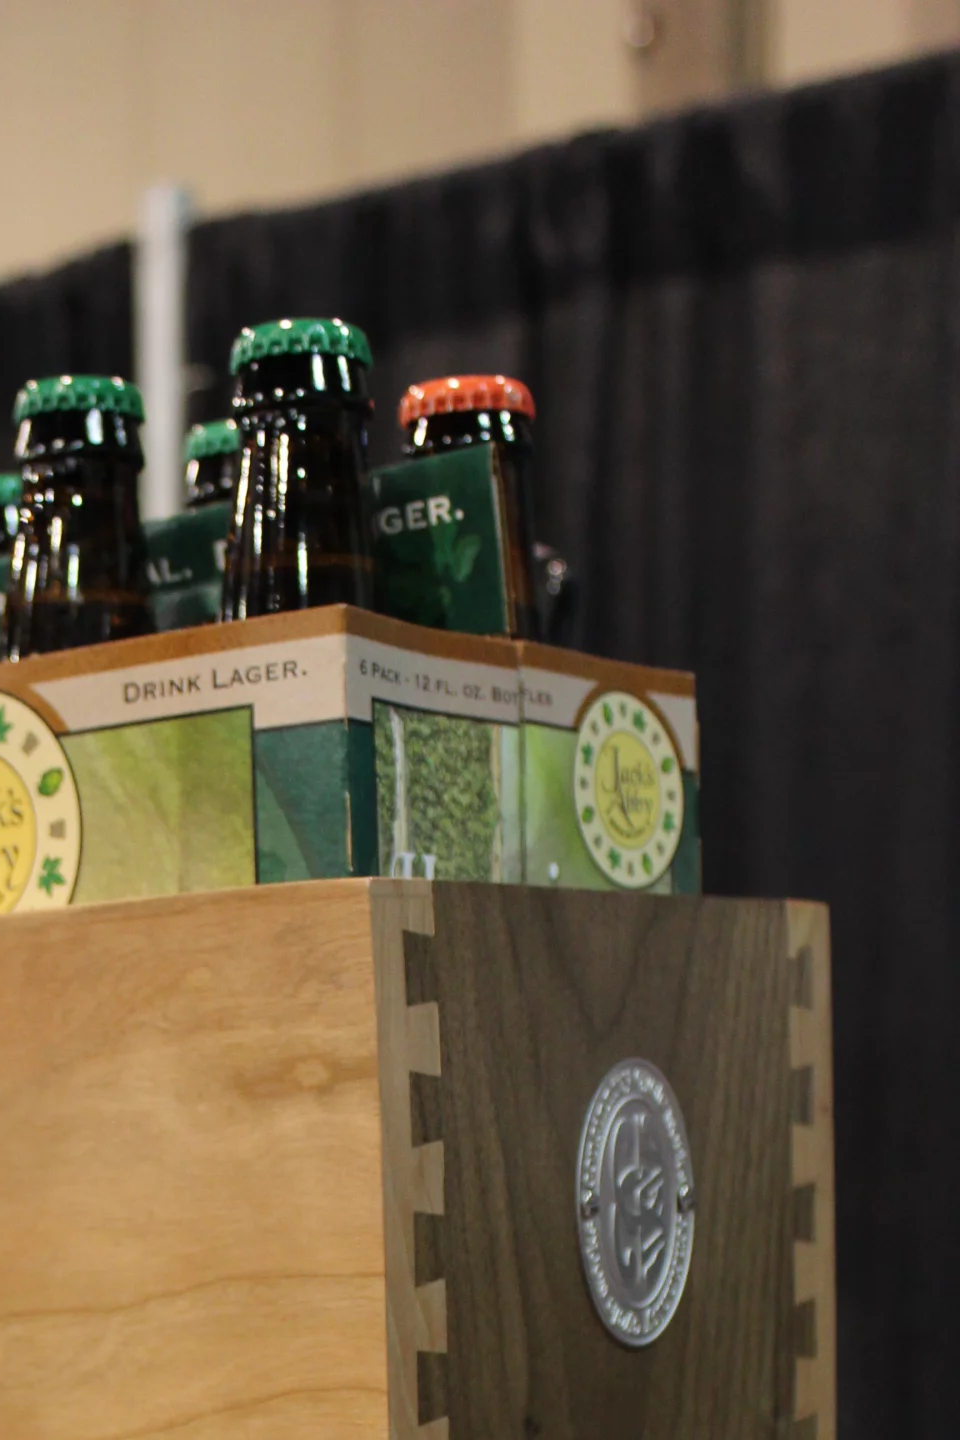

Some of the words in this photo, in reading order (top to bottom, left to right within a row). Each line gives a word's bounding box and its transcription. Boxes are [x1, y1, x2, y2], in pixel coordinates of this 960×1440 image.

[374, 495, 464, 537] GER.
[123, 675, 201, 703] DRINK
[211, 660, 308, 690] LAGER.
